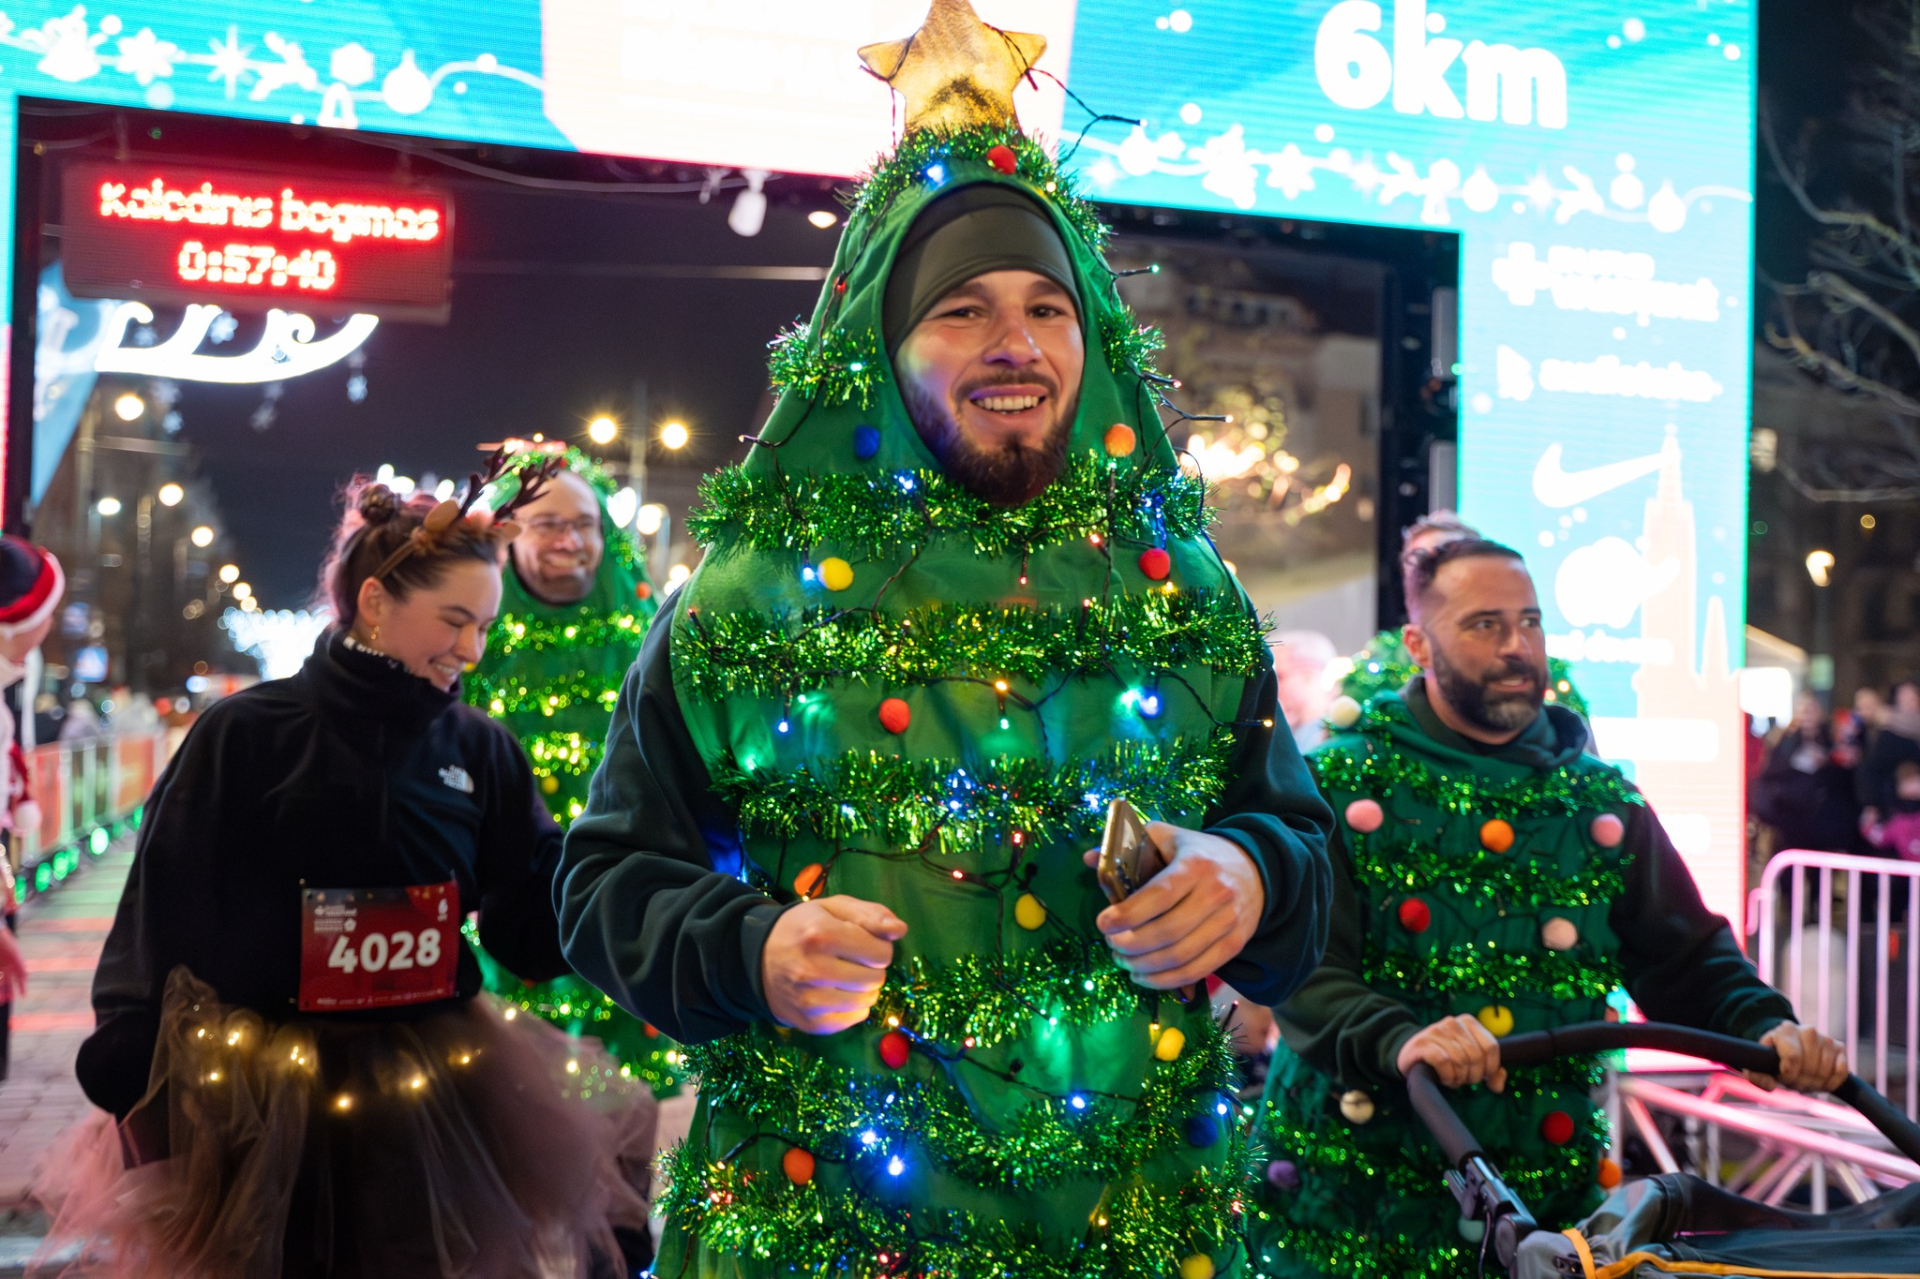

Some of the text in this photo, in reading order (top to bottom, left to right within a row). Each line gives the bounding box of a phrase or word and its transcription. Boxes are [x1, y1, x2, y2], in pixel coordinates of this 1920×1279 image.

[1314, 0, 1568, 129] 6km
[178, 241, 336, 290] 0:57:40
[327, 927, 442, 974] 4028
